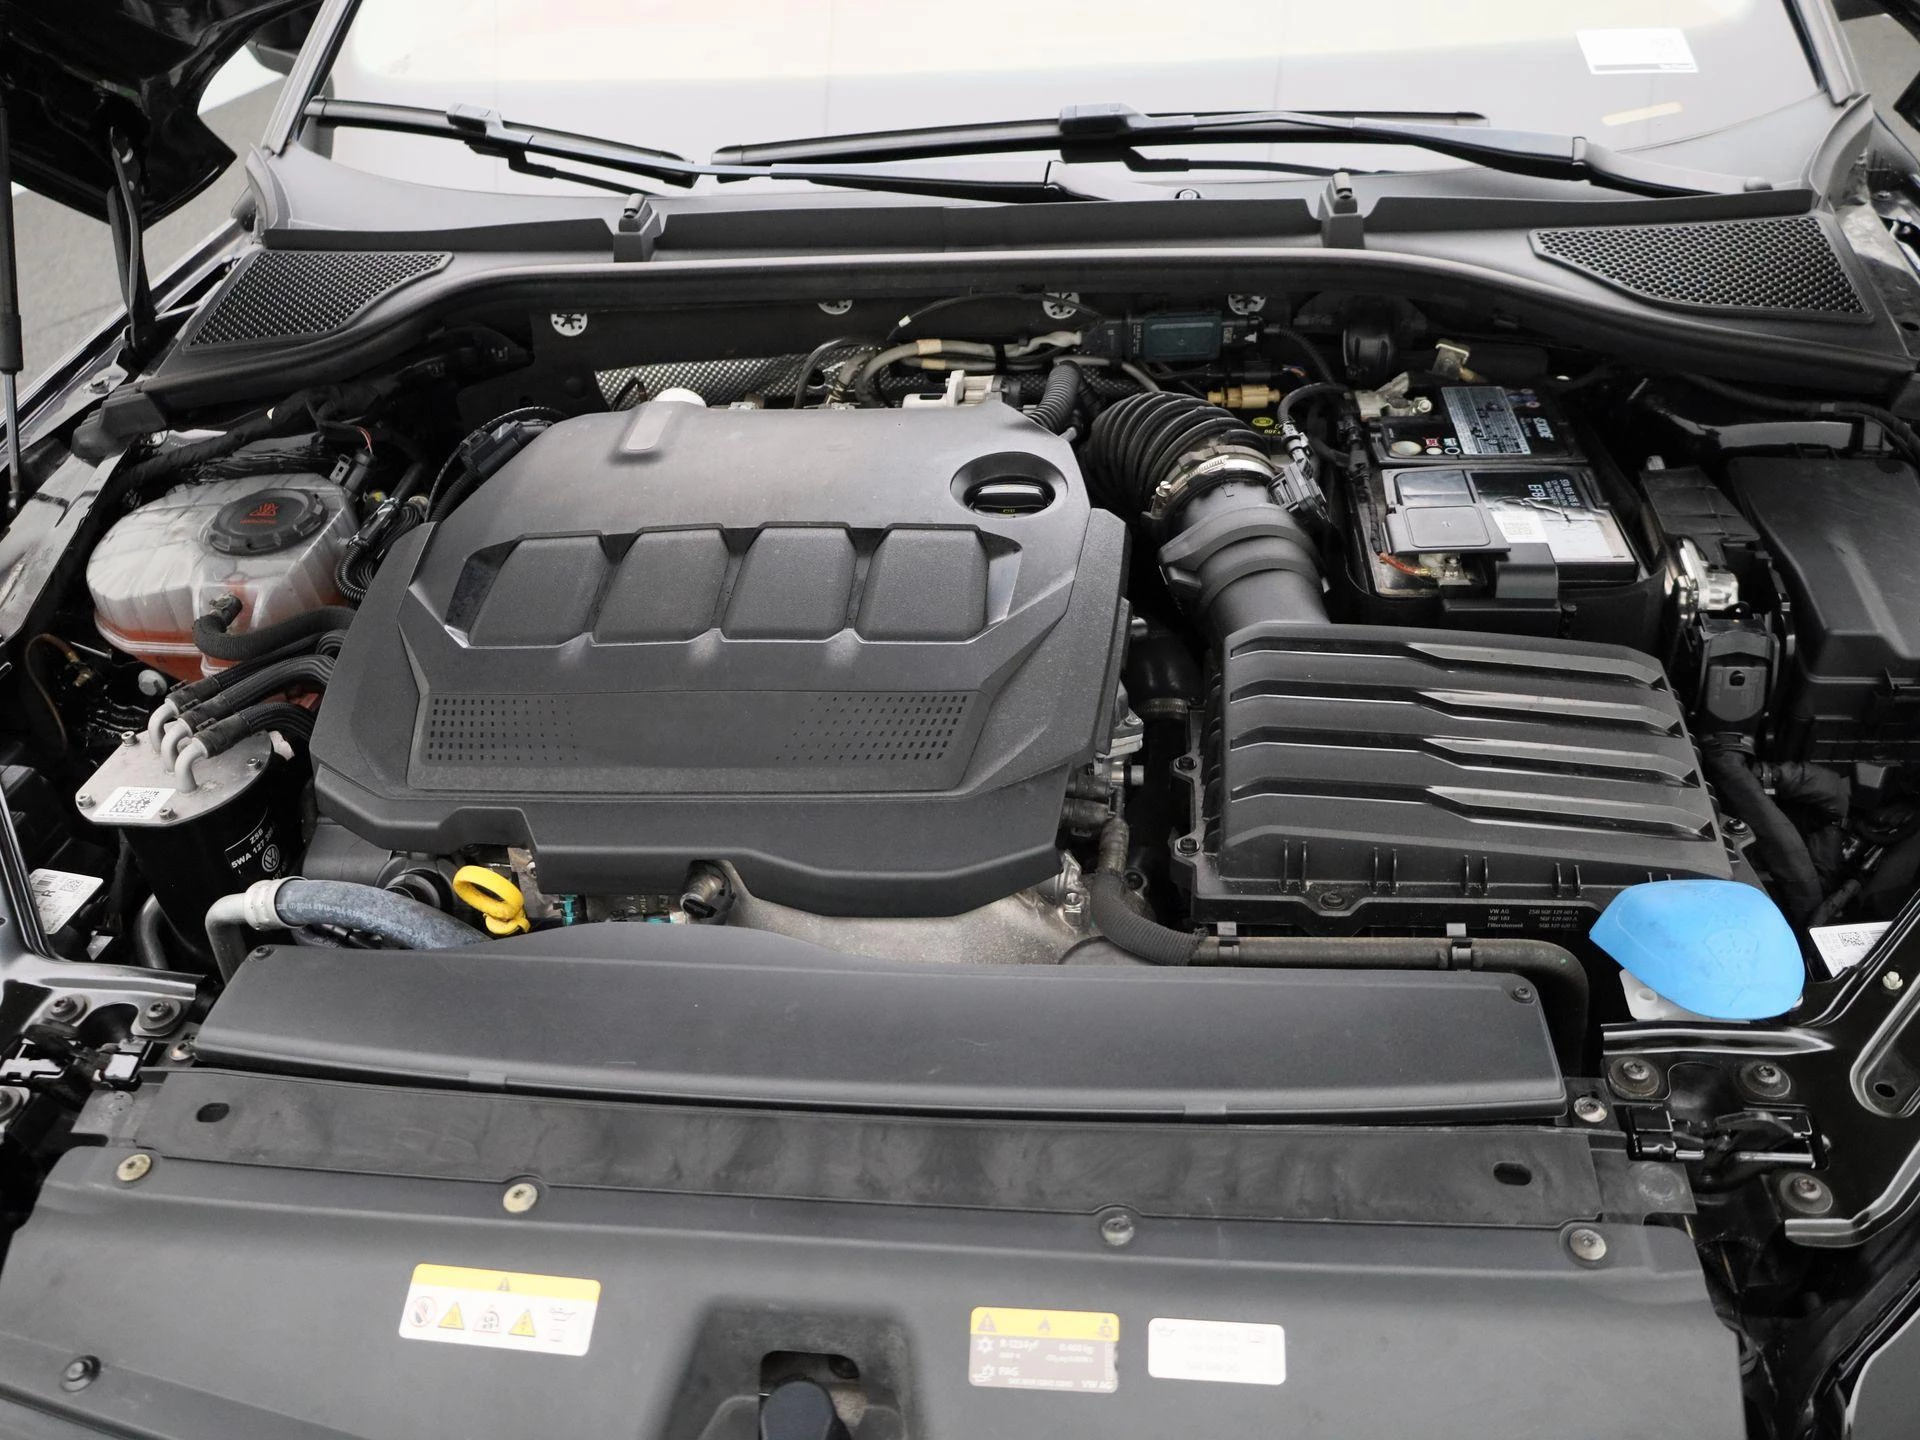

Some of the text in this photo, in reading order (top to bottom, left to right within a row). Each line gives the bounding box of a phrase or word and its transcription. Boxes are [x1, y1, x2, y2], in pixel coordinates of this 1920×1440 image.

[249, 828, 264, 844] ZSB
[231, 852, 252, 868] 5WA
[252, 839, 265, 853] 127
